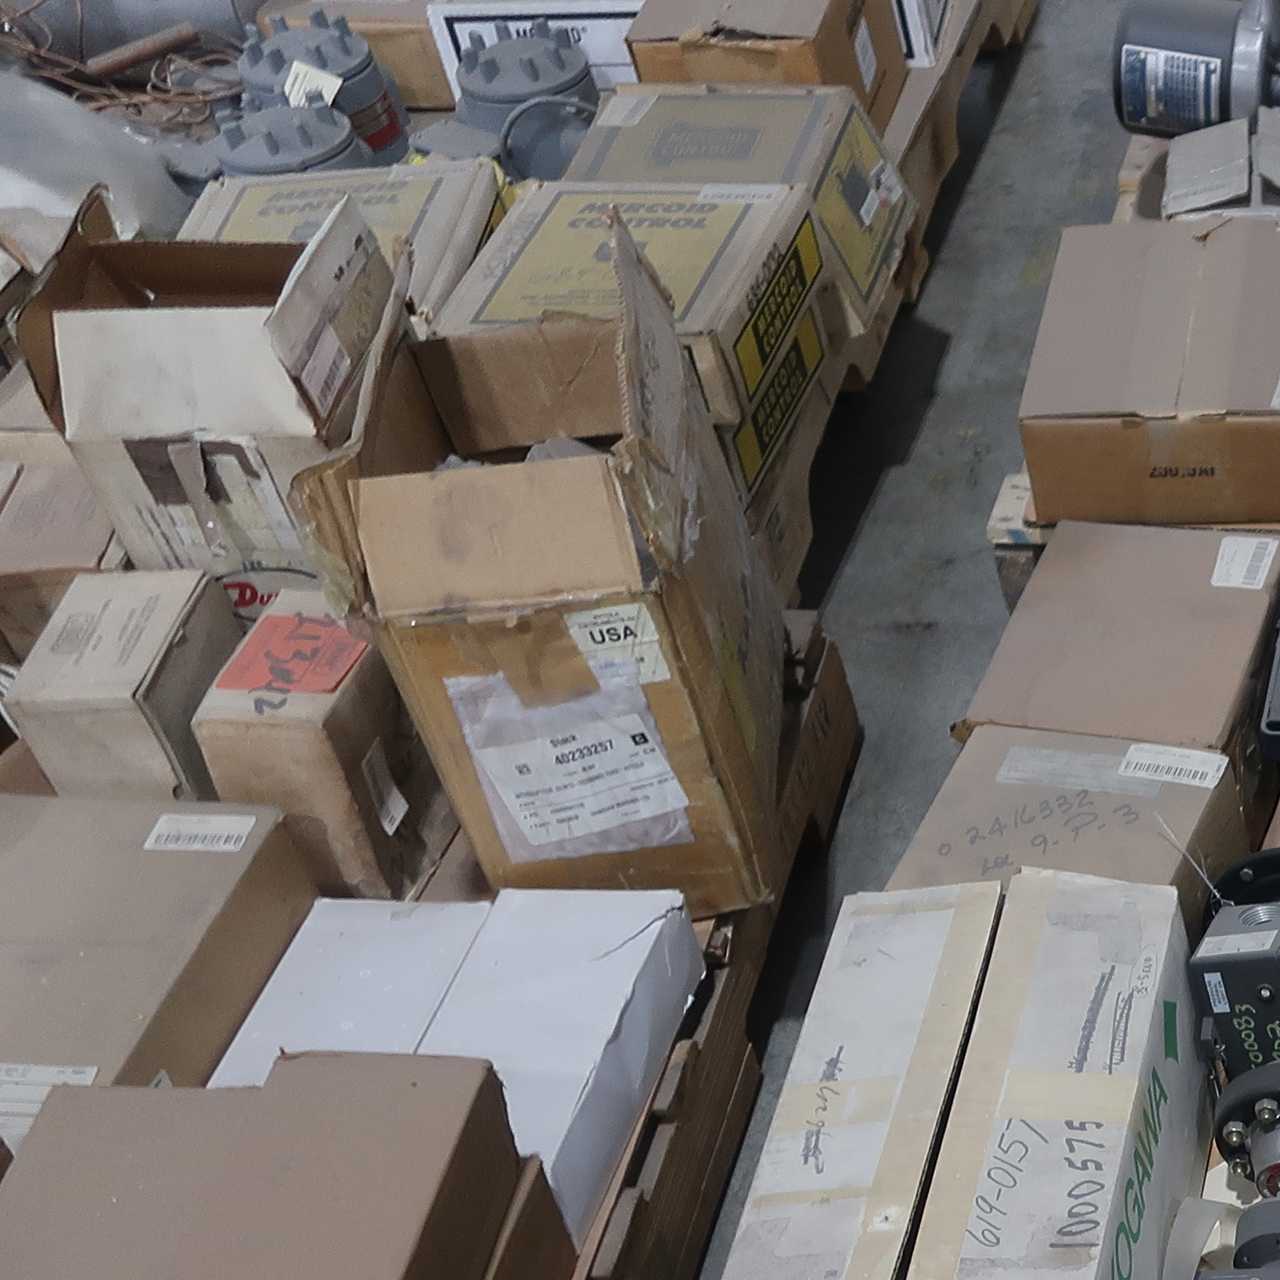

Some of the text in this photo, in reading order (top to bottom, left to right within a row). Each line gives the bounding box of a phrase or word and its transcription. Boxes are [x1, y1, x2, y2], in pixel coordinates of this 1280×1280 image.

[589, 625, 638, 645] USA
[966, 1118, 1049, 1248] 619-0157
[1049, 1119, 1105, 1248] 1000575
